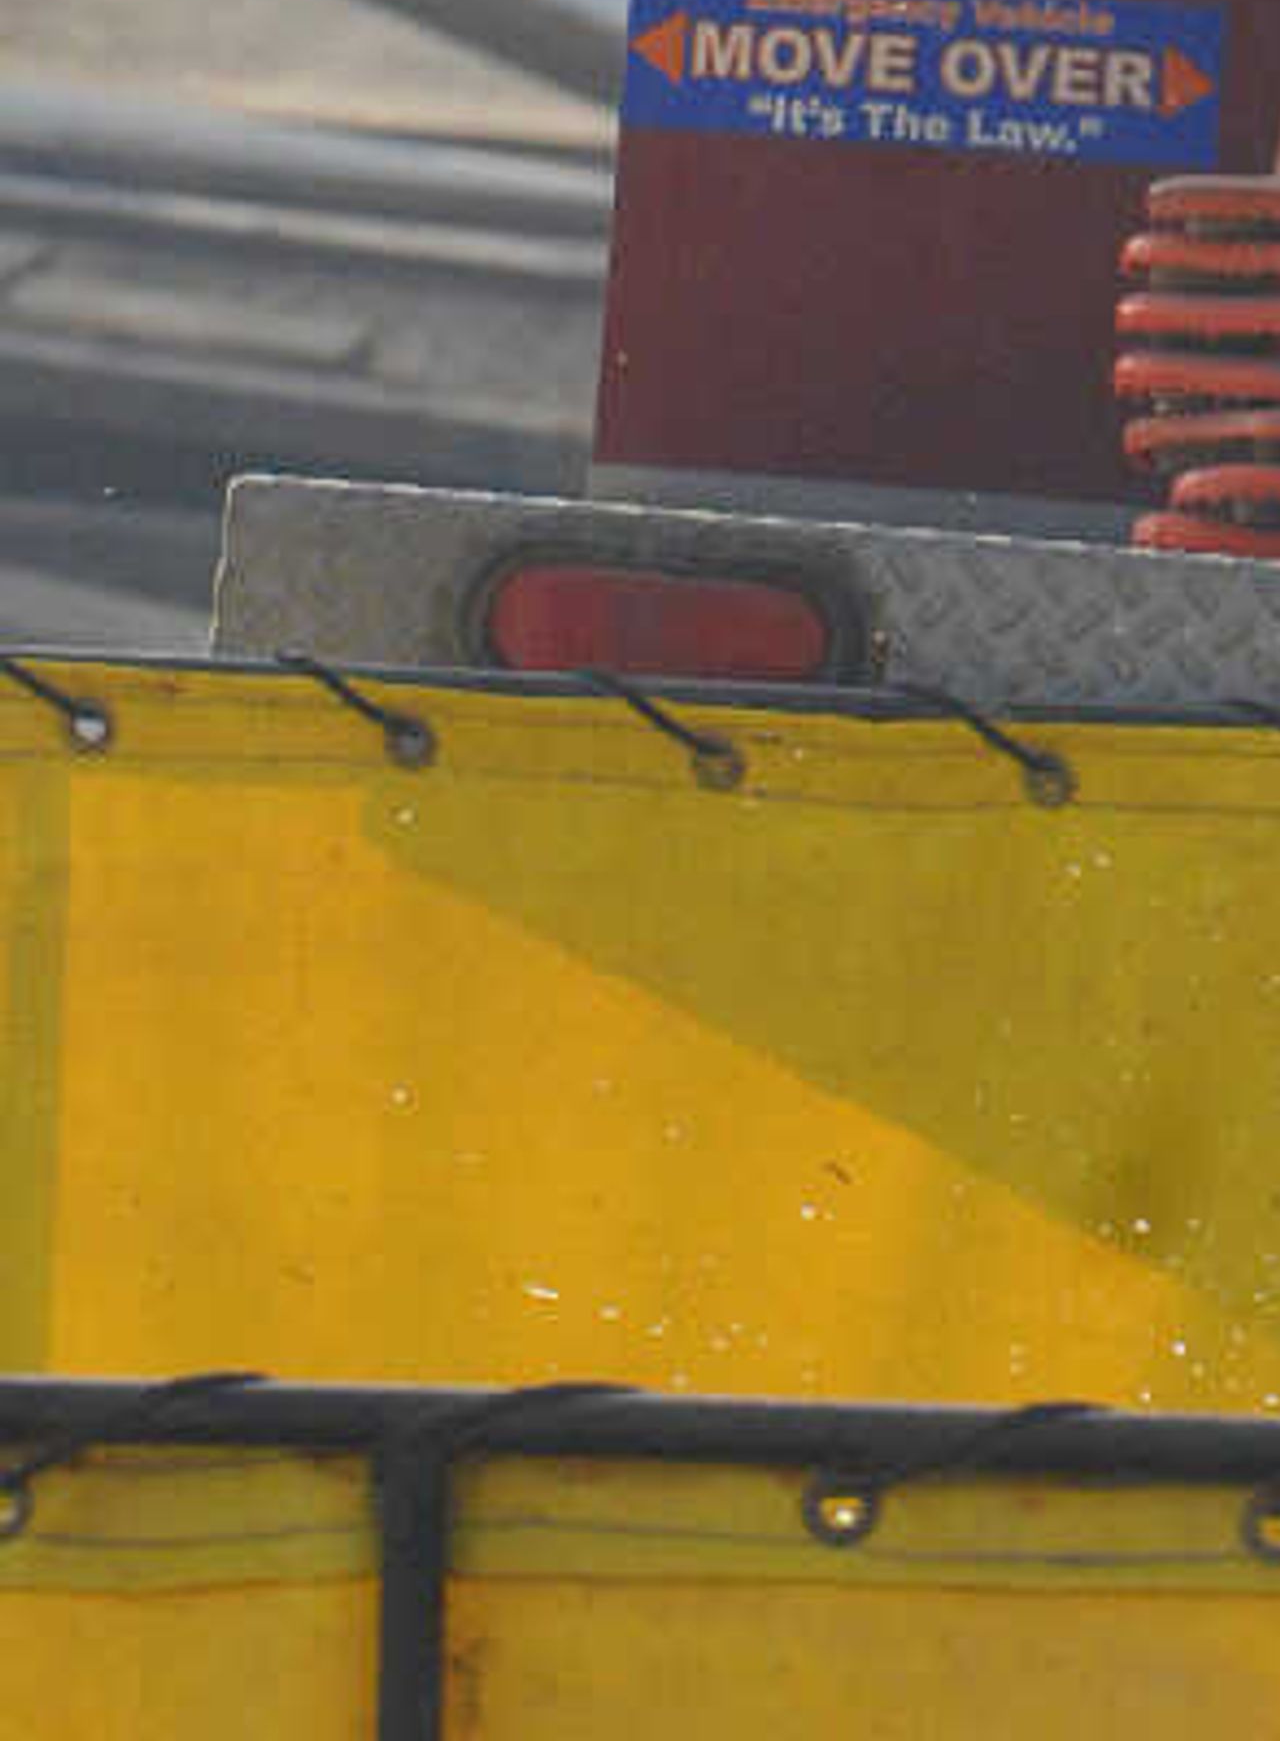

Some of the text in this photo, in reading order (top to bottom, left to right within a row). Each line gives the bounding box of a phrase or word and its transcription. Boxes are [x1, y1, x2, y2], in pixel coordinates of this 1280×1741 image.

[691, 20, 1153, 107] MOVE OVER
[858, 101, 951, 142] The
